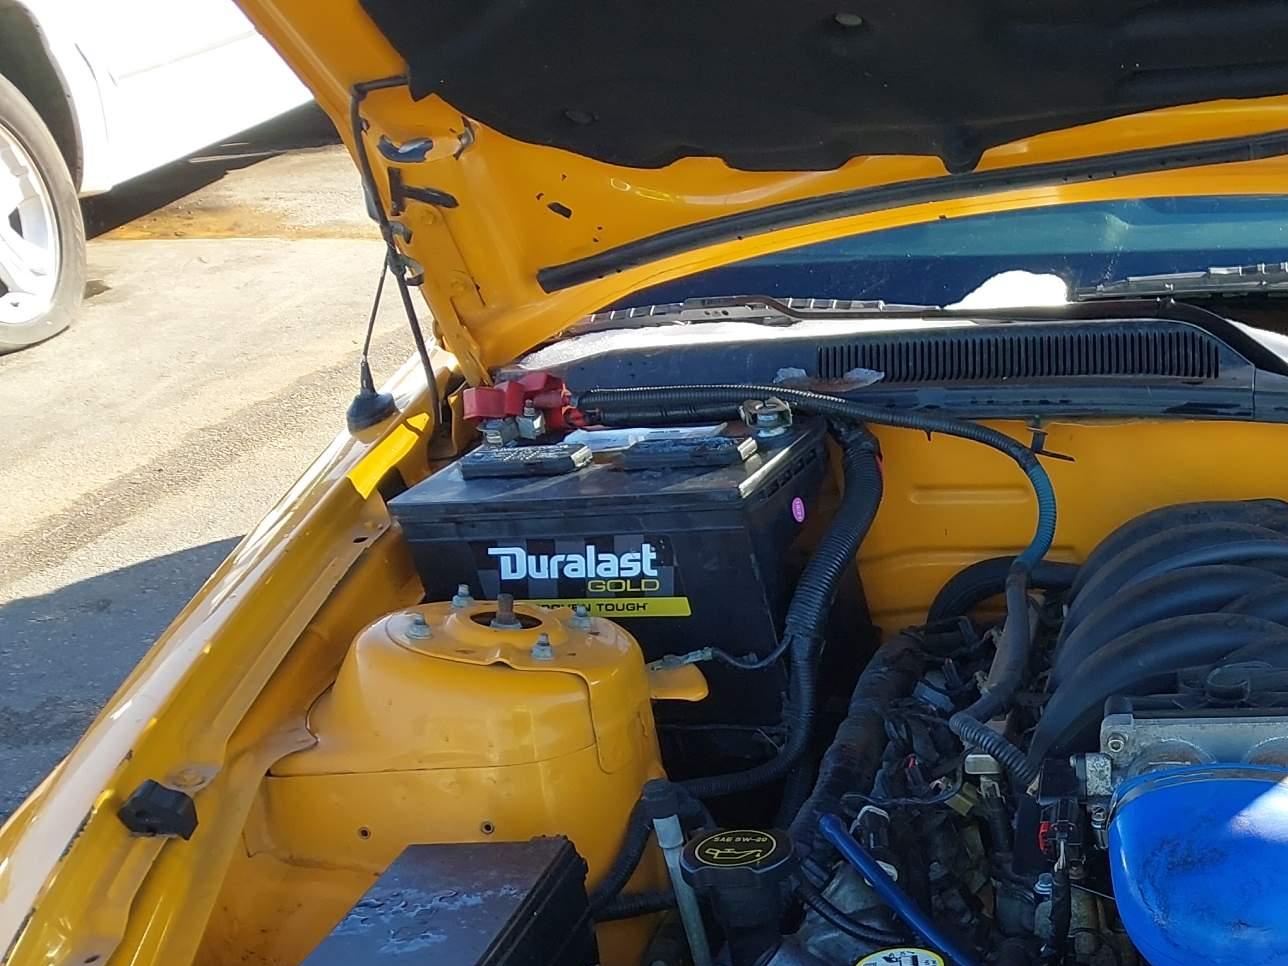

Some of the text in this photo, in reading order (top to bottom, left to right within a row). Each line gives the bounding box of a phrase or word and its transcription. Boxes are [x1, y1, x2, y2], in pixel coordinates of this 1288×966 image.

[487, 543, 658, 580] Duralast
[587, 579, 660, 592] GOLD
[596, 602, 647, 612] TOUGH
